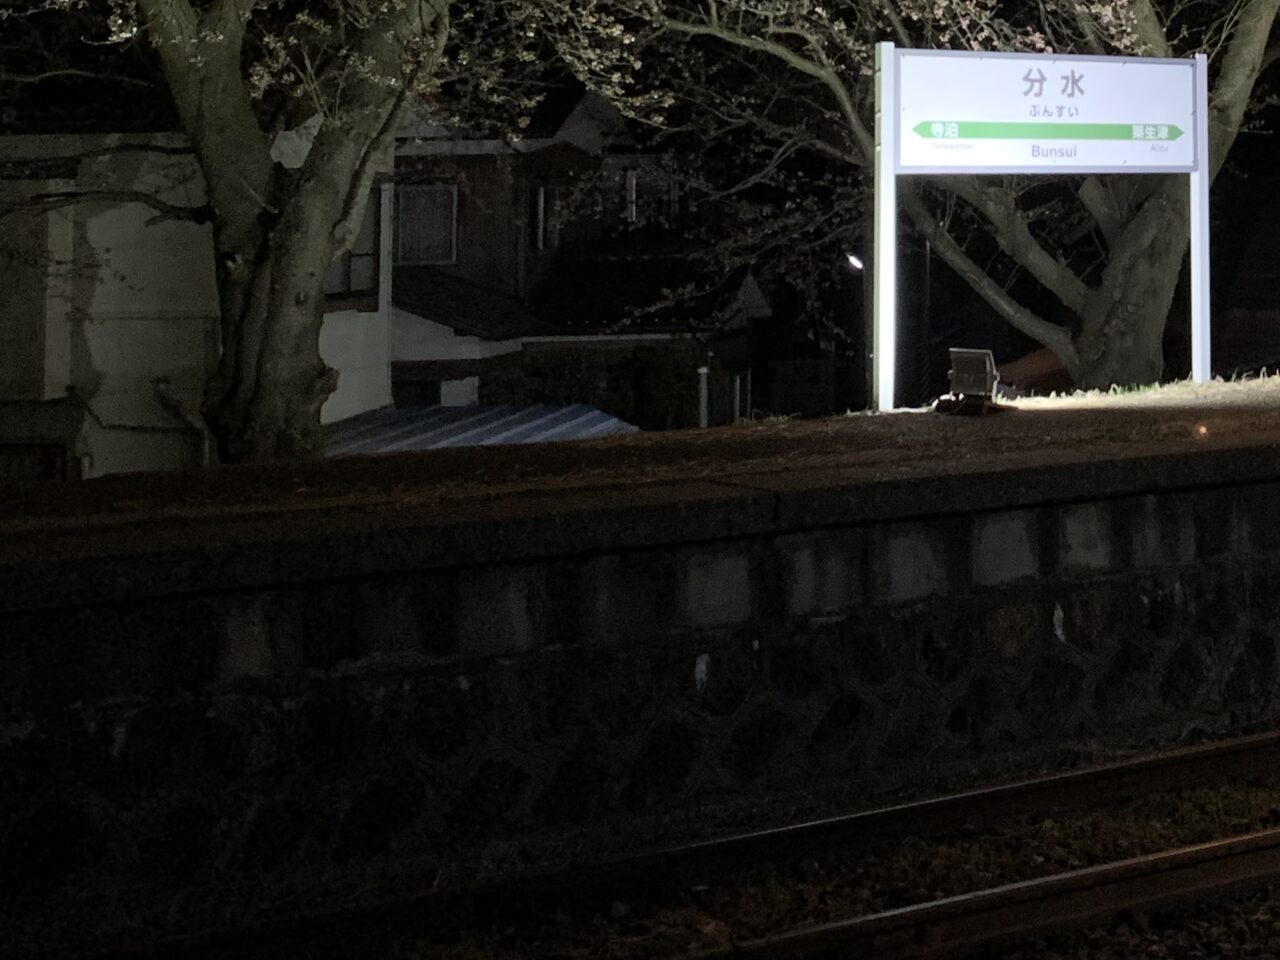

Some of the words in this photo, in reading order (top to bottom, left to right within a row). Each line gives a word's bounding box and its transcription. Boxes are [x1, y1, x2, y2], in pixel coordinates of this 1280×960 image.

[1022, 67, 1086, 98] 分水
[1029, 105, 1079, 118] ぶんすい
[1031, 144, 1078, 158] Bunsui
